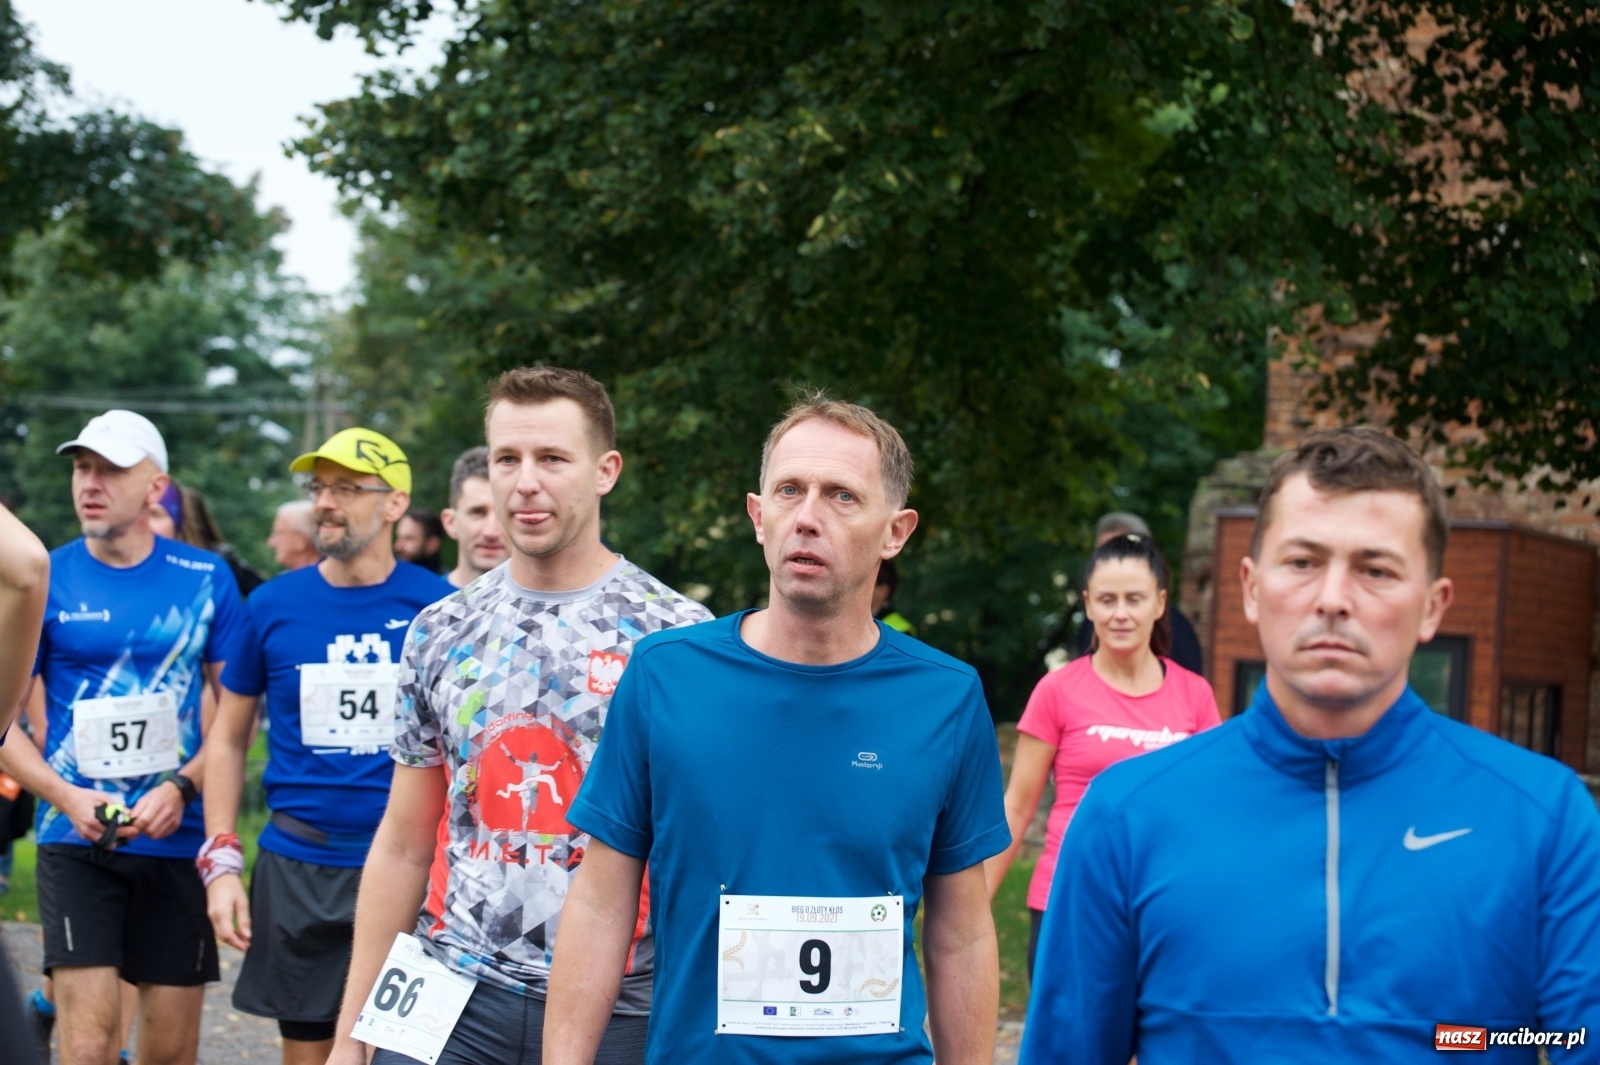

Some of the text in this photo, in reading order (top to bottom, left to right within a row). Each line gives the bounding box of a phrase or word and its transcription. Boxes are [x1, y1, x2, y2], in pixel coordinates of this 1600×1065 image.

[340, 690, 379, 720] 54
[111, 720, 147, 752] 57
[791, 905, 805, 914] BIEG
[810, 905, 828, 914] ZŁOTY
[828, 906, 844, 914] KŁOS
[796, 913, 838, 923] 19.09.2021
[799, 938, 832, 995] 9
[373, 967, 425, 1018] 66
